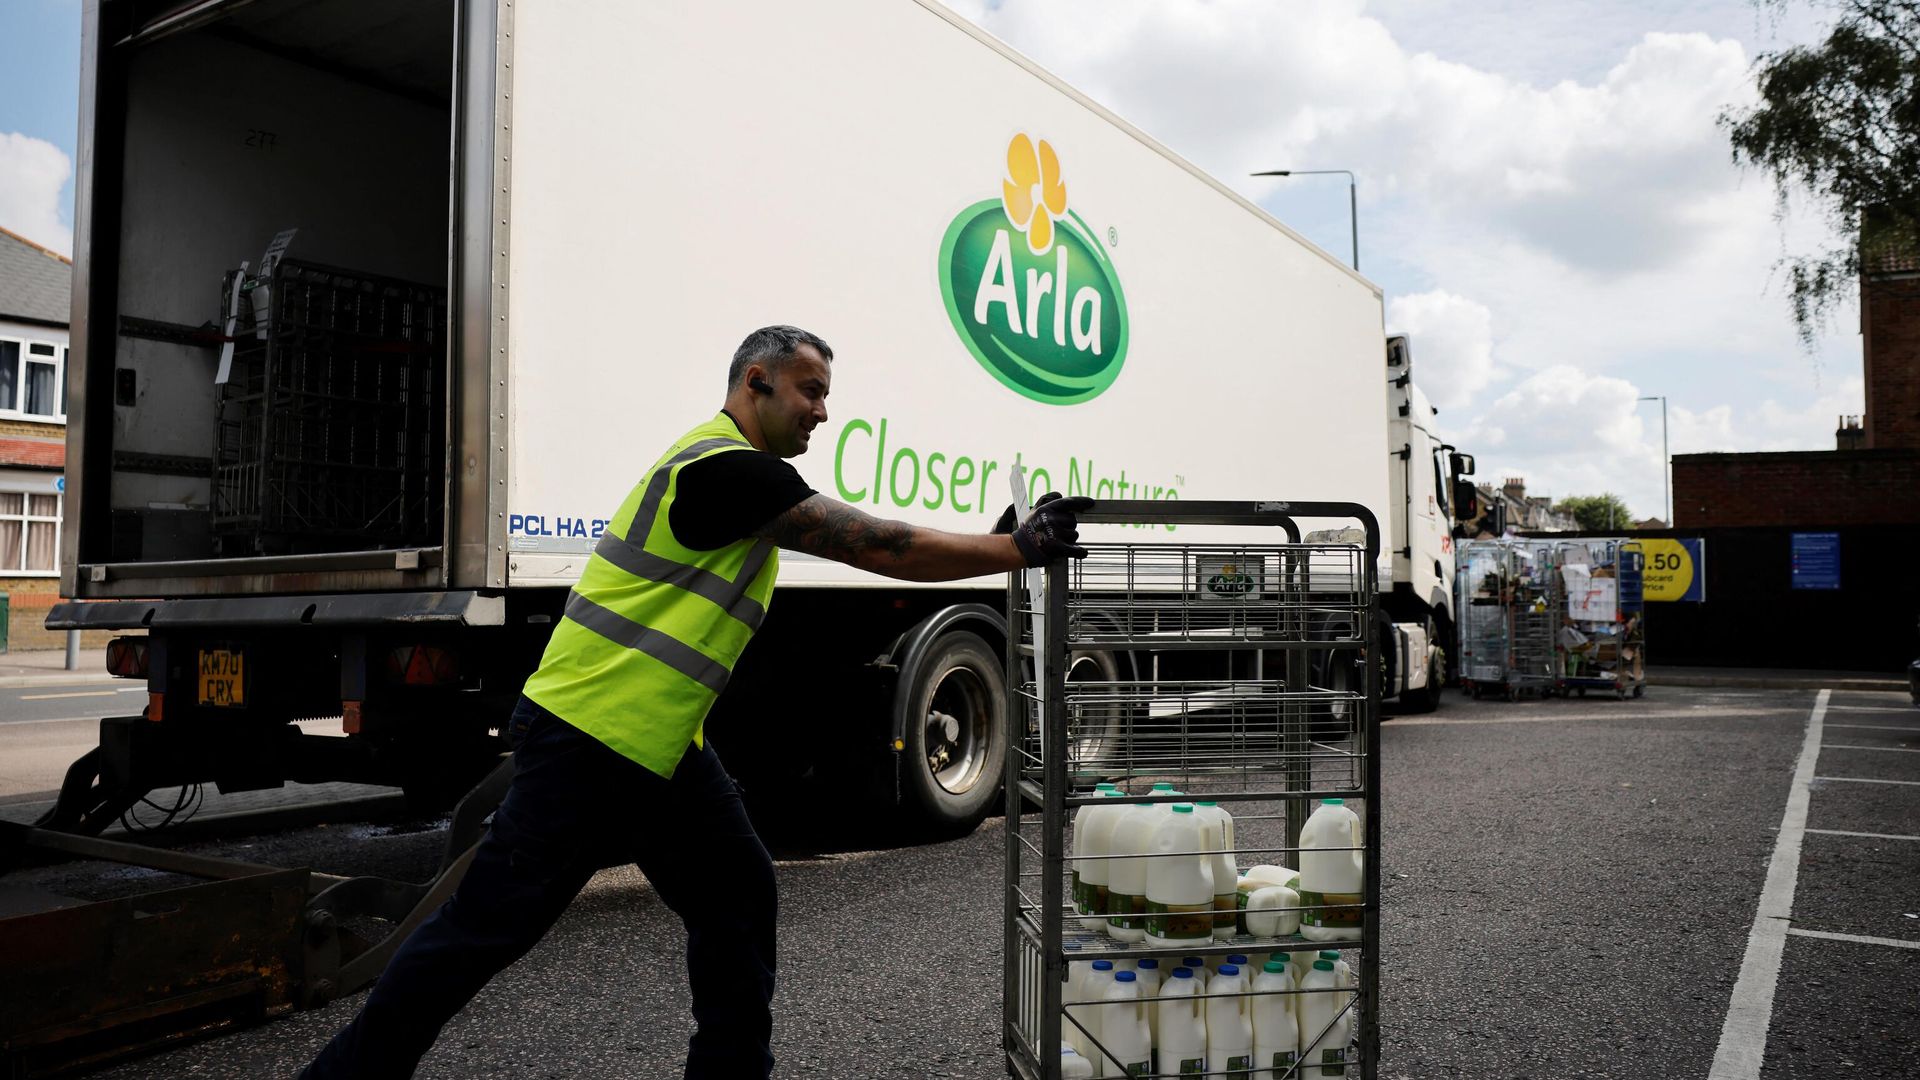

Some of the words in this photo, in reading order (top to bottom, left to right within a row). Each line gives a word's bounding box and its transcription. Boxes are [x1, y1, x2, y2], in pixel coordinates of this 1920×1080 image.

[245, 128, 278, 152] 277
[974, 228, 1102, 356] Arla
[834, 418, 998, 514] Closer
[509, 514, 552, 536] PCL
[556, 517, 588, 538] HA
[591, 518, 611, 539] 2
[207, 679, 234, 702] CRX
